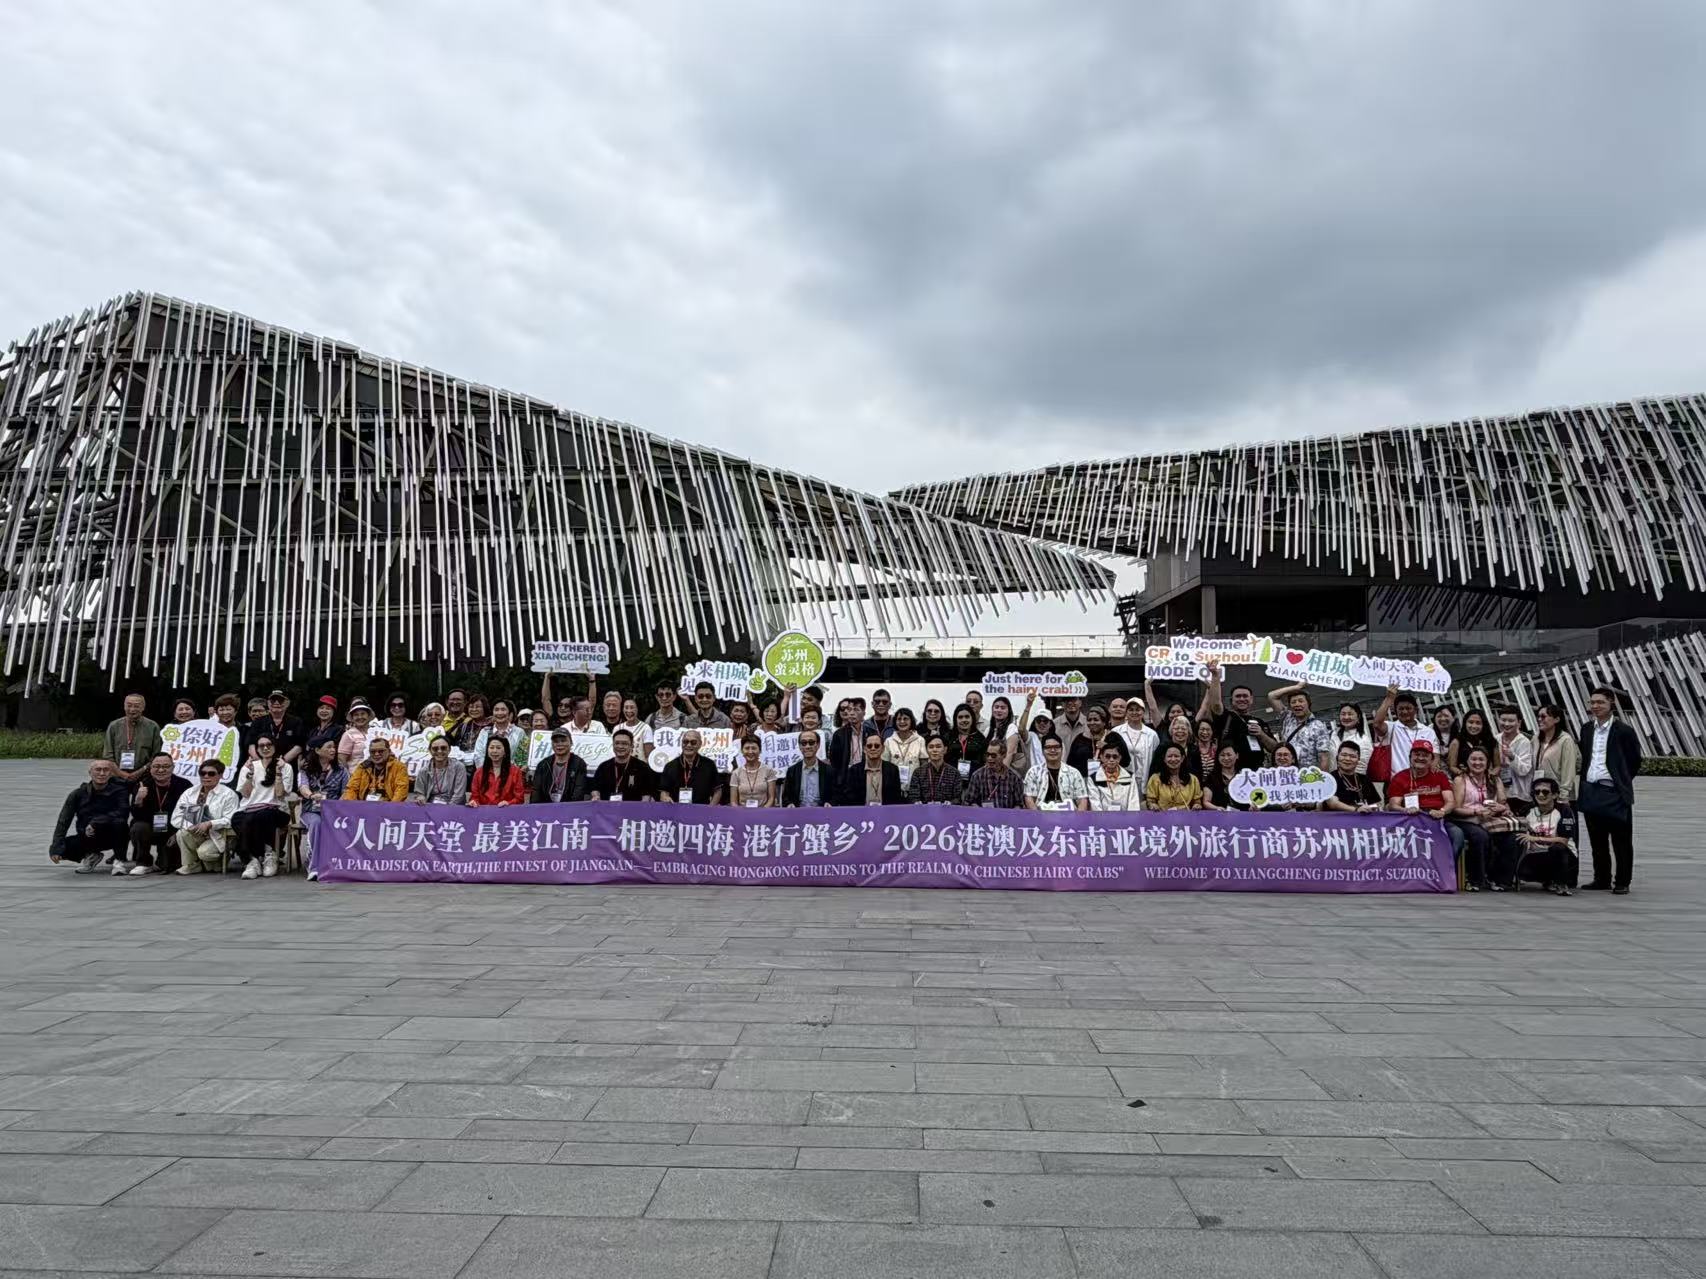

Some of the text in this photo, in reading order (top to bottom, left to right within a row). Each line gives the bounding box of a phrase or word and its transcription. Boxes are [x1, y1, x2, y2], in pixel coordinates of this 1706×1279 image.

[538, 643, 596, 653] HEY THERE
[1172, 638, 1242, 650] Welcome
[535, 653, 607, 662] XIANGCHENG!
[780, 648, 808, 661] 苏州
[1175, 651, 1256, 663] to Suzhou!
[1272, 647, 1283, 663] I
[1306, 652, 1354, 677] 相城
[1359, 658, 1416, 674] 人间天堂
[696, 661, 747, 679] 来相城
[1147, 666, 1225, 679] MODE O
[1270, 665, 1351, 687] XIANGCHENG
[985, 674, 1062, 684] Just here for
[985, 684, 1072, 694] the hairy crab!
[347, 859, 409, 872] PARADISE
[411, 859, 429, 872] ON
[504, 859, 548, 873] FINEST
[550, 860, 569, 872] OF
[729, 865, 799, 879] HONGKONG
[803, 864, 857, 877] FRIENDS
[859, 863, 877, 876] TO
[880, 862, 905, 875] THE
[908, 861, 952, 874] REALM
[955, 863, 972, 876] OF
[974, 865, 1030, 878] CHINESE
[1033, 866, 1074, 879] HAIRY
[1144, 866, 1208, 879] WELCOME
[1213, 867, 1231, 879] TO
[1233, 867, 1321, 880] XIANGCHENG
[1324, 868, 1384, 881] DISTRICT,
